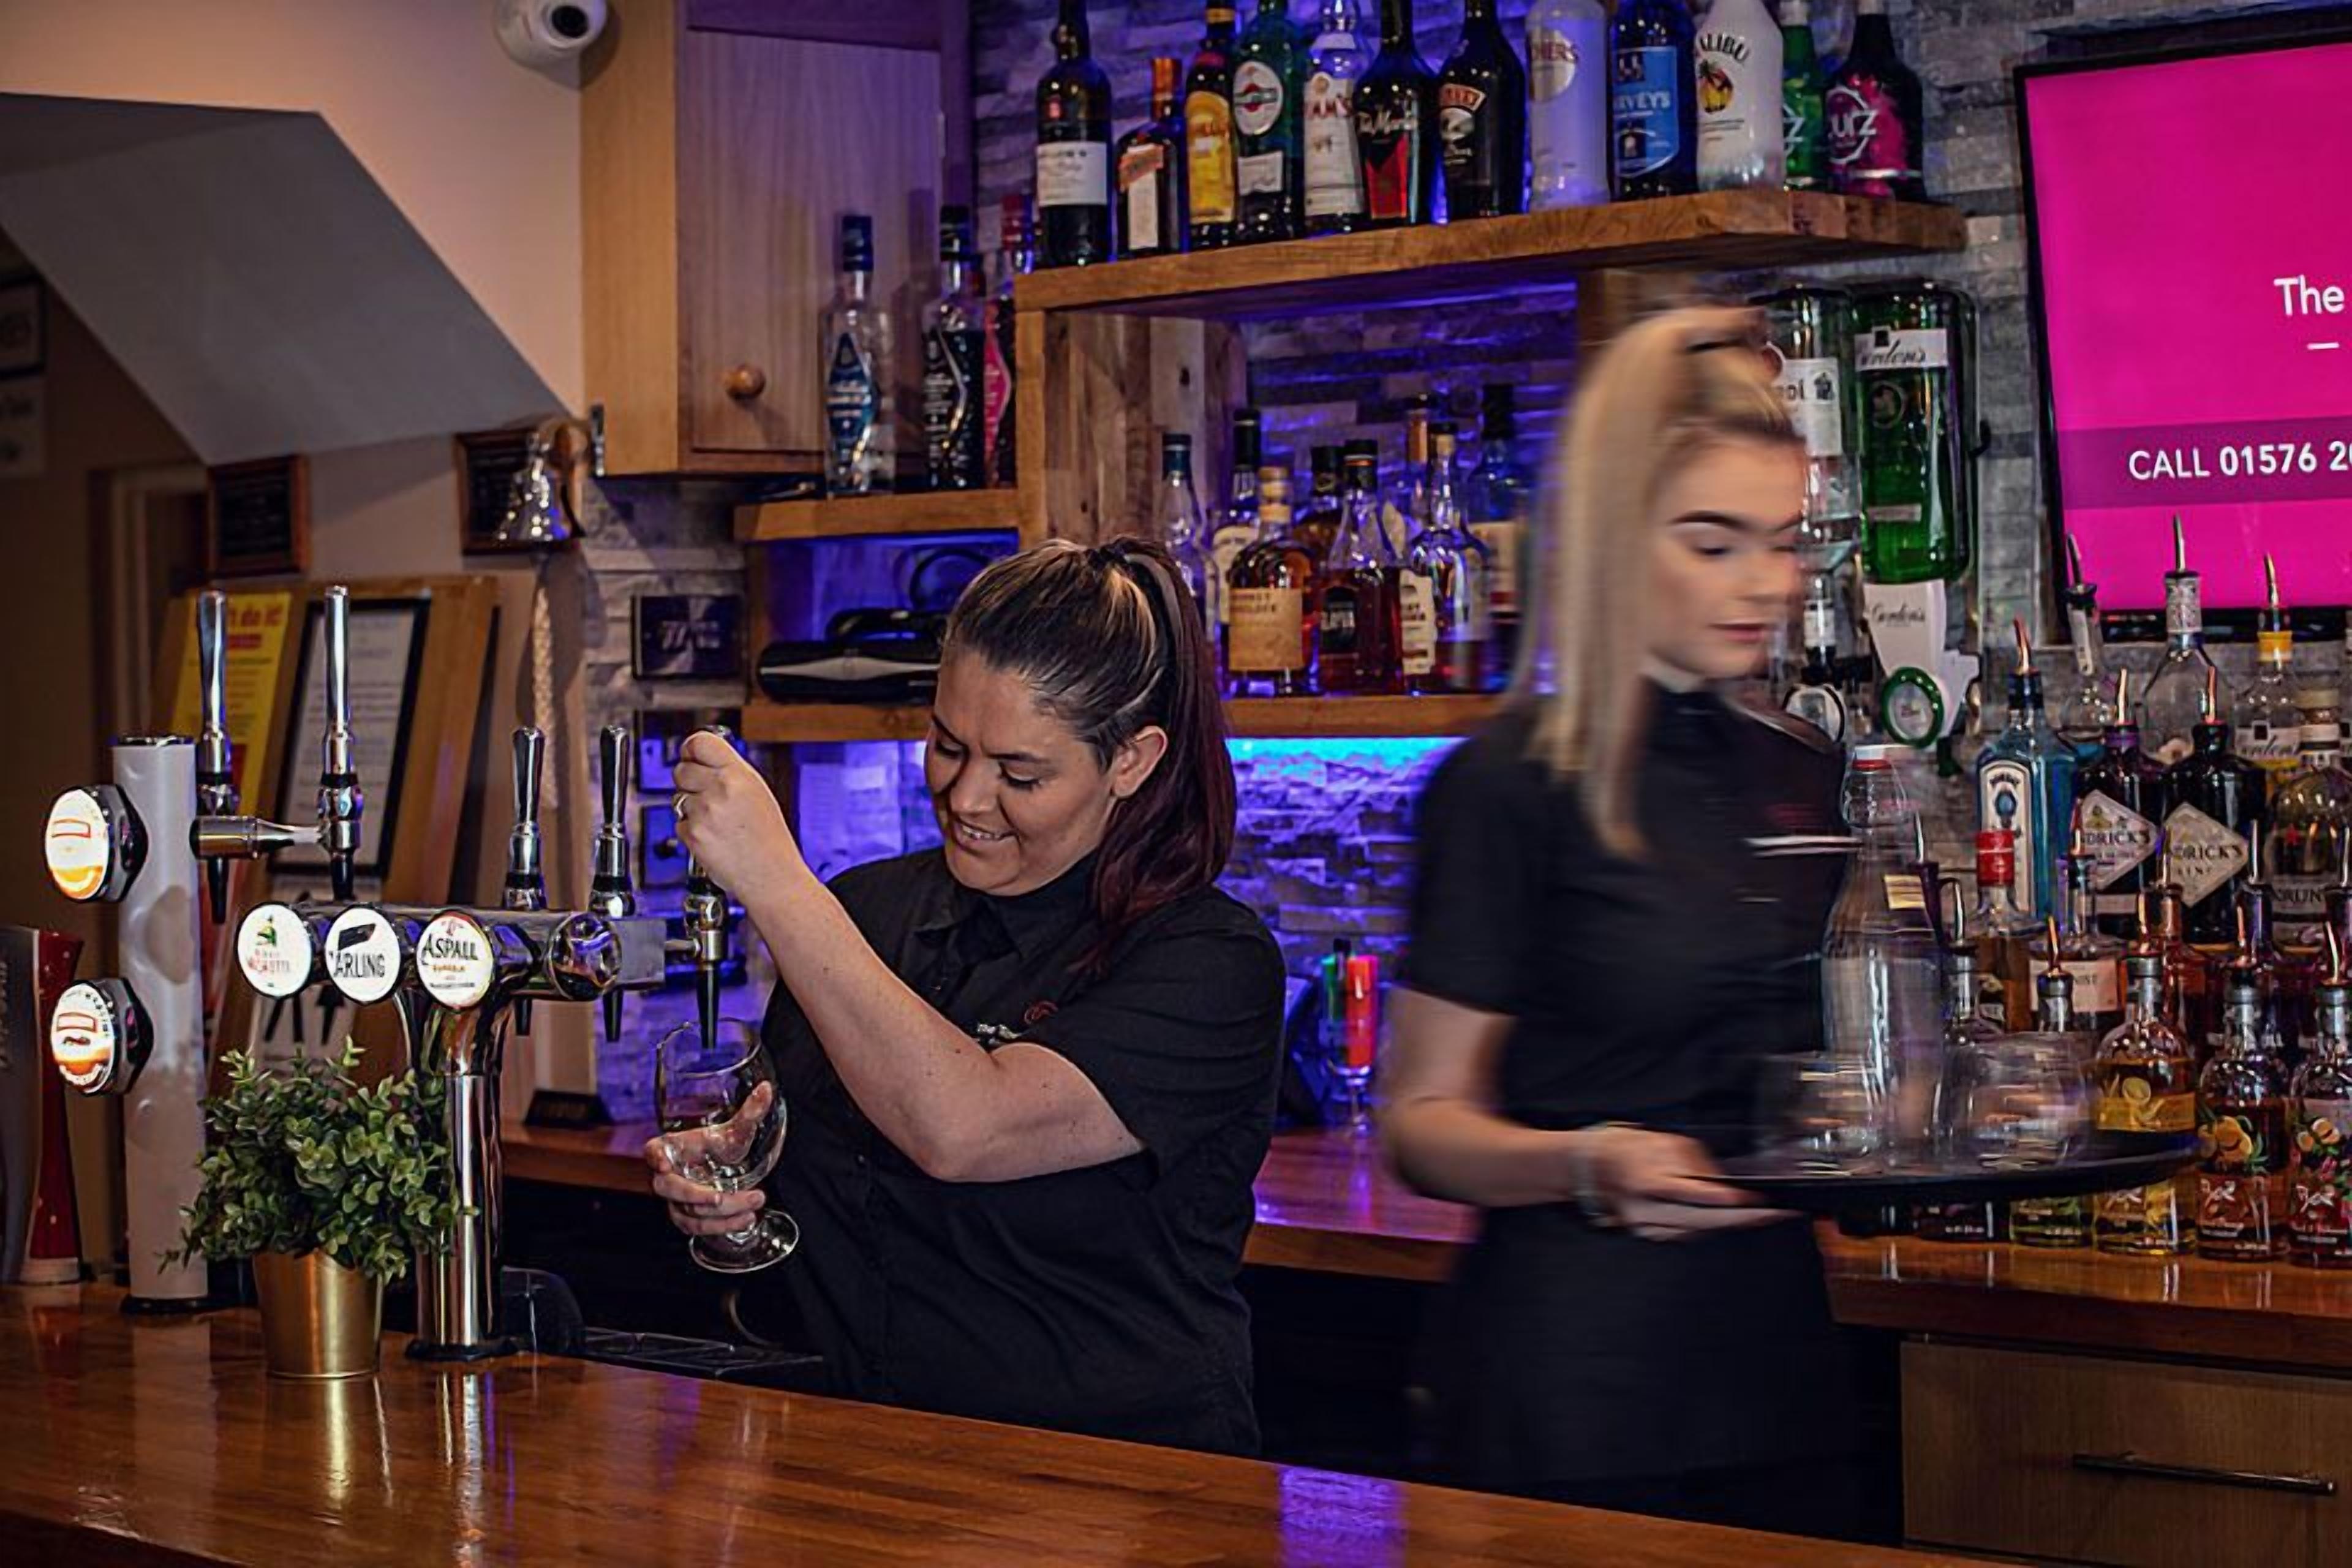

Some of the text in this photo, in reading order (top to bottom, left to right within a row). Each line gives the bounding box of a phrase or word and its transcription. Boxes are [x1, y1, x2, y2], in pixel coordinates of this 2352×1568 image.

[2274, 274, 2345, 316] The
[2128, 440, 2352, 481] CALL 01576 2
[420, 932, 478, 966] ASPALL
